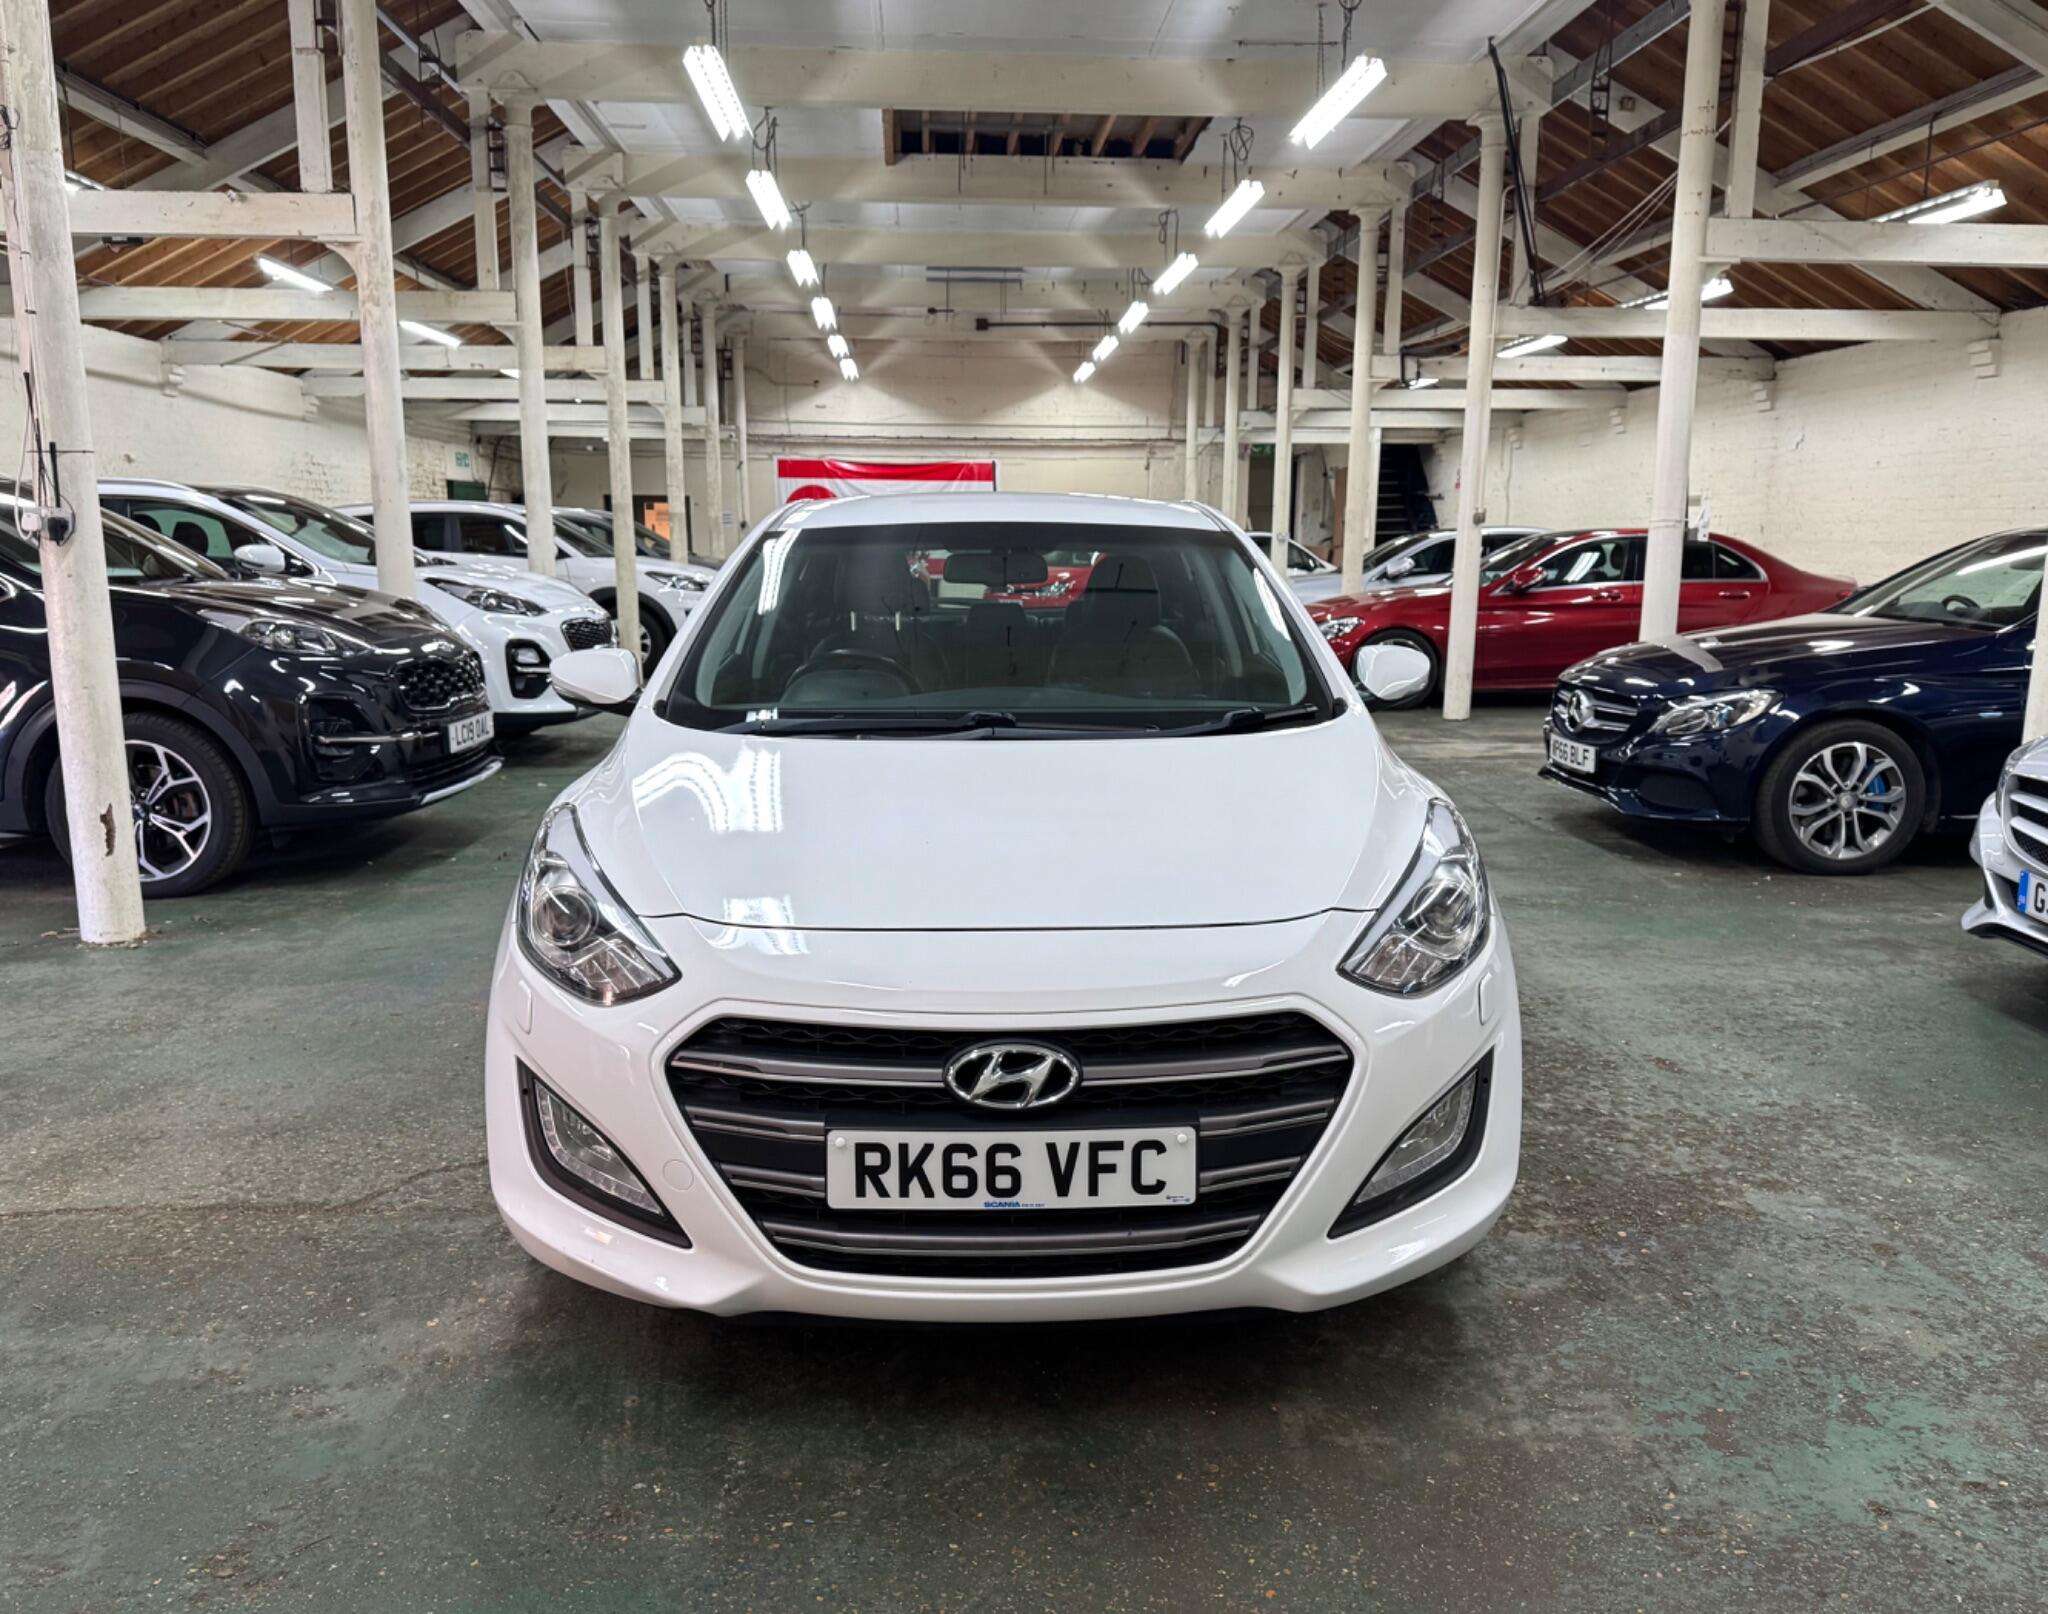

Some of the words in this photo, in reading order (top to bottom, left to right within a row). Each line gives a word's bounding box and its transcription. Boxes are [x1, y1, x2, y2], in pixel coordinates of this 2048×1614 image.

[1570, 744, 1590, 767] BLF
[2034, 881, 2048, 913] G
[854, 1142, 1023, 1199] RK66
[1045, 1139, 1168, 1198] VFC
